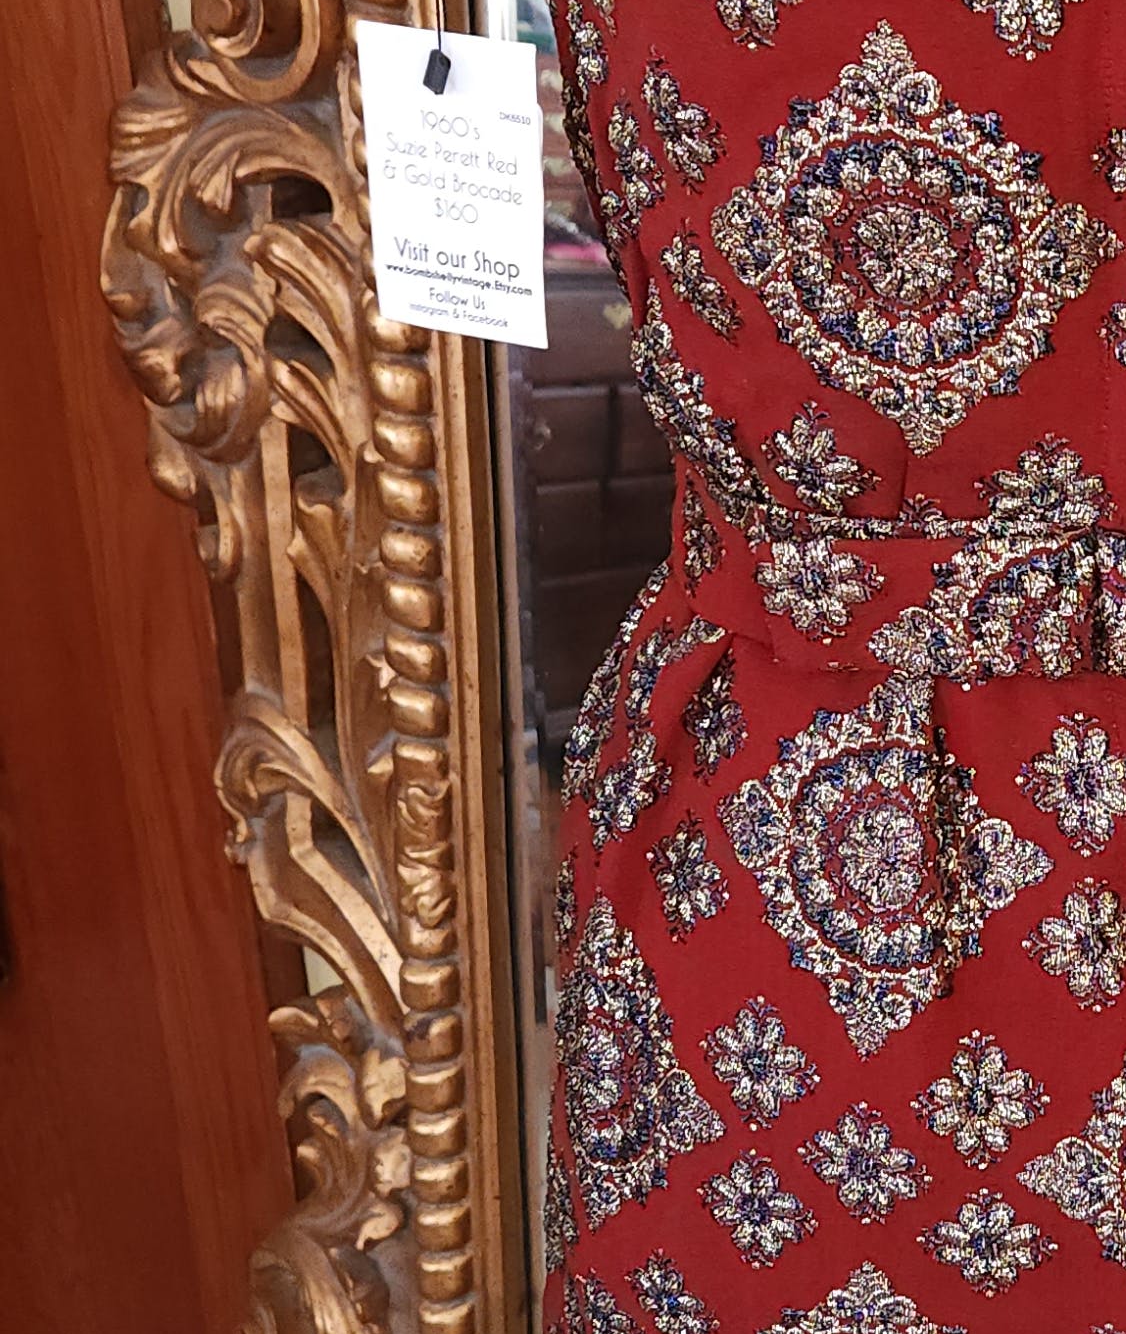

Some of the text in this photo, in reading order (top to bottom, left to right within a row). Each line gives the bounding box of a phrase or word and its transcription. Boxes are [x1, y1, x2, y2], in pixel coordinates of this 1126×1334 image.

[420, 109, 481, 140] 1960's
[386, 131, 428, 158] Suzie
[487, 151, 518, 176] Red
[383, 159, 523, 206] & Gold Brocade
[434, 197, 479, 224] $160
[394, 236, 520, 282] Visit our Shop
[429, 287, 486, 310] Follow Us
